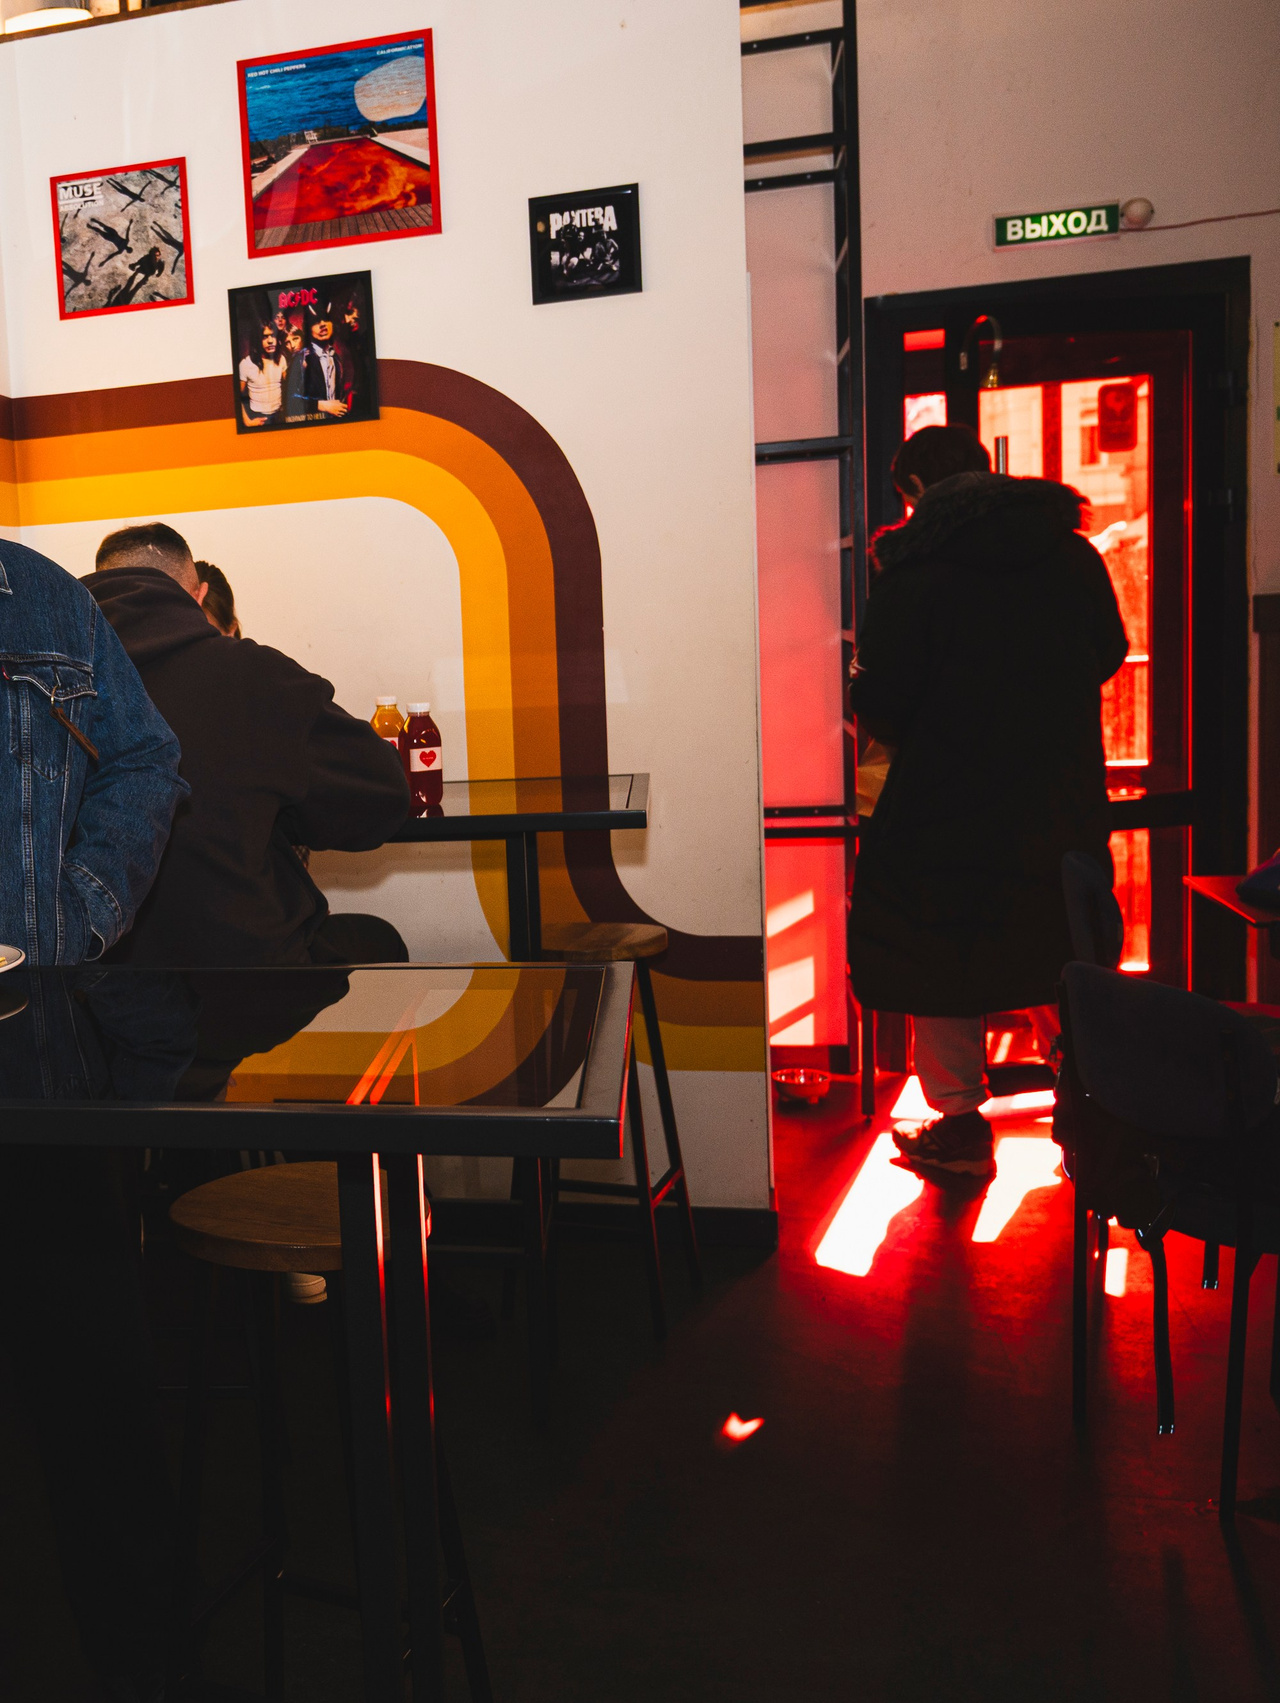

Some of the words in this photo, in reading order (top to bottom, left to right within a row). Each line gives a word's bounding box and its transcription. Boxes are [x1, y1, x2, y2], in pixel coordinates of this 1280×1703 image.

[59, 182, 103, 200] MUSE
[549, 205, 618, 240] PANTERA
[1006, 209, 1109, 242] ВЫХОД
